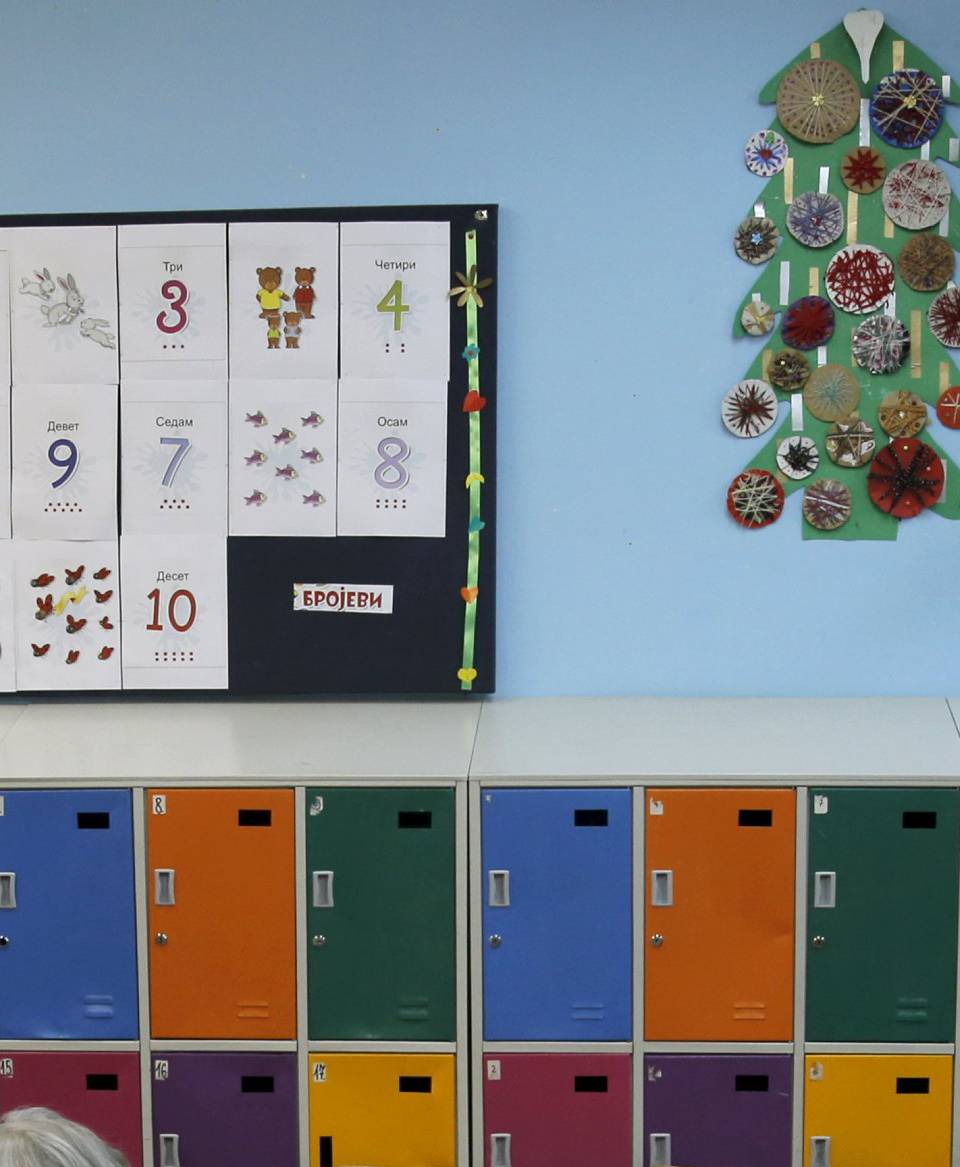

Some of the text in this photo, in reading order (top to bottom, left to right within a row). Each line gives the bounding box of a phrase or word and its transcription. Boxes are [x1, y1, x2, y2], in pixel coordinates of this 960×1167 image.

[163, 261, 183, 274] Три
[375, 259, 416, 273] Четири
[156, 279, 190, 334] 3
[376, 279, 410, 332] 4
[47, 420, 80, 433] Девет
[156, 416, 194, 428] Седам
[378, 416, 408, 427] Осам
[47, 438, 80, 489] 9
[159, 437, 191, 486] 7
[374, 437, 411, 487] 8
[156, 570, 189, 584] Десет
[145, 587, 197, 634] 10
